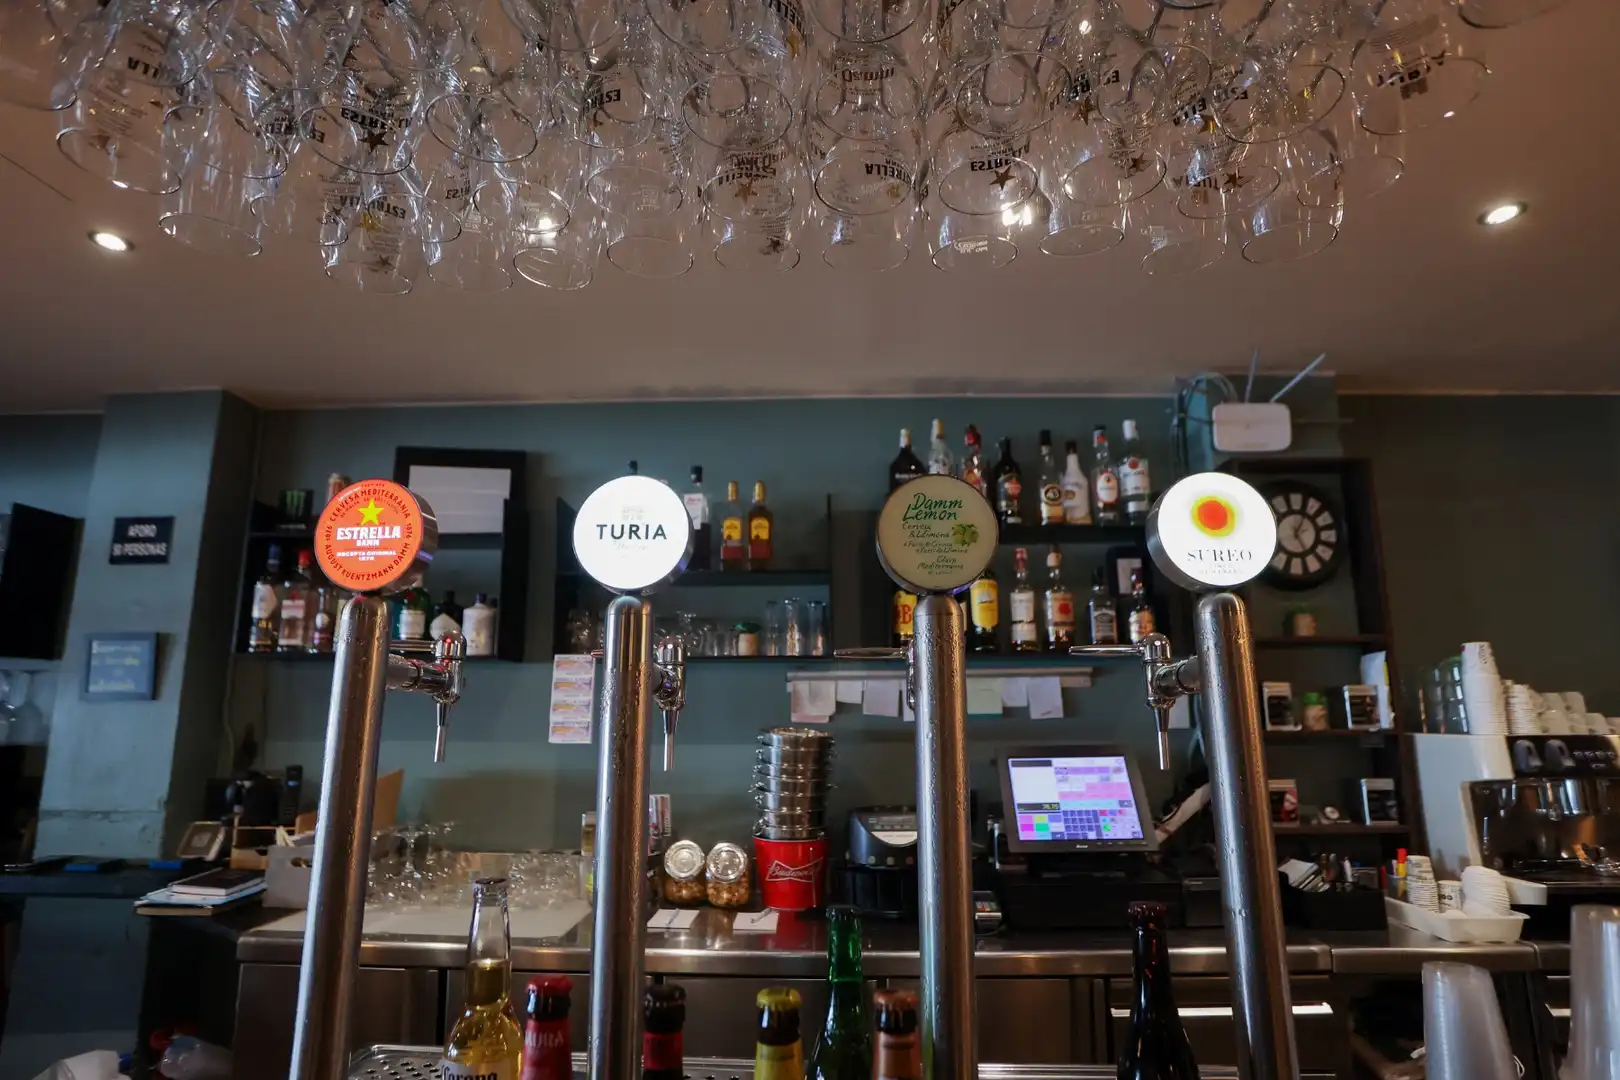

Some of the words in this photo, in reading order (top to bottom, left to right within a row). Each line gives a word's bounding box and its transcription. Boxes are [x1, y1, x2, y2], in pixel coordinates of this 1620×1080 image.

[911, 492, 963, 510] Damm
[902, 504, 957, 521] Lemon
[336, 526, 401, 540] ESTRELLA
[596, 524, 667, 540] TURIA
[393, 542, 411, 566] DAMM
[1187, 548, 1253, 563] SUREO
